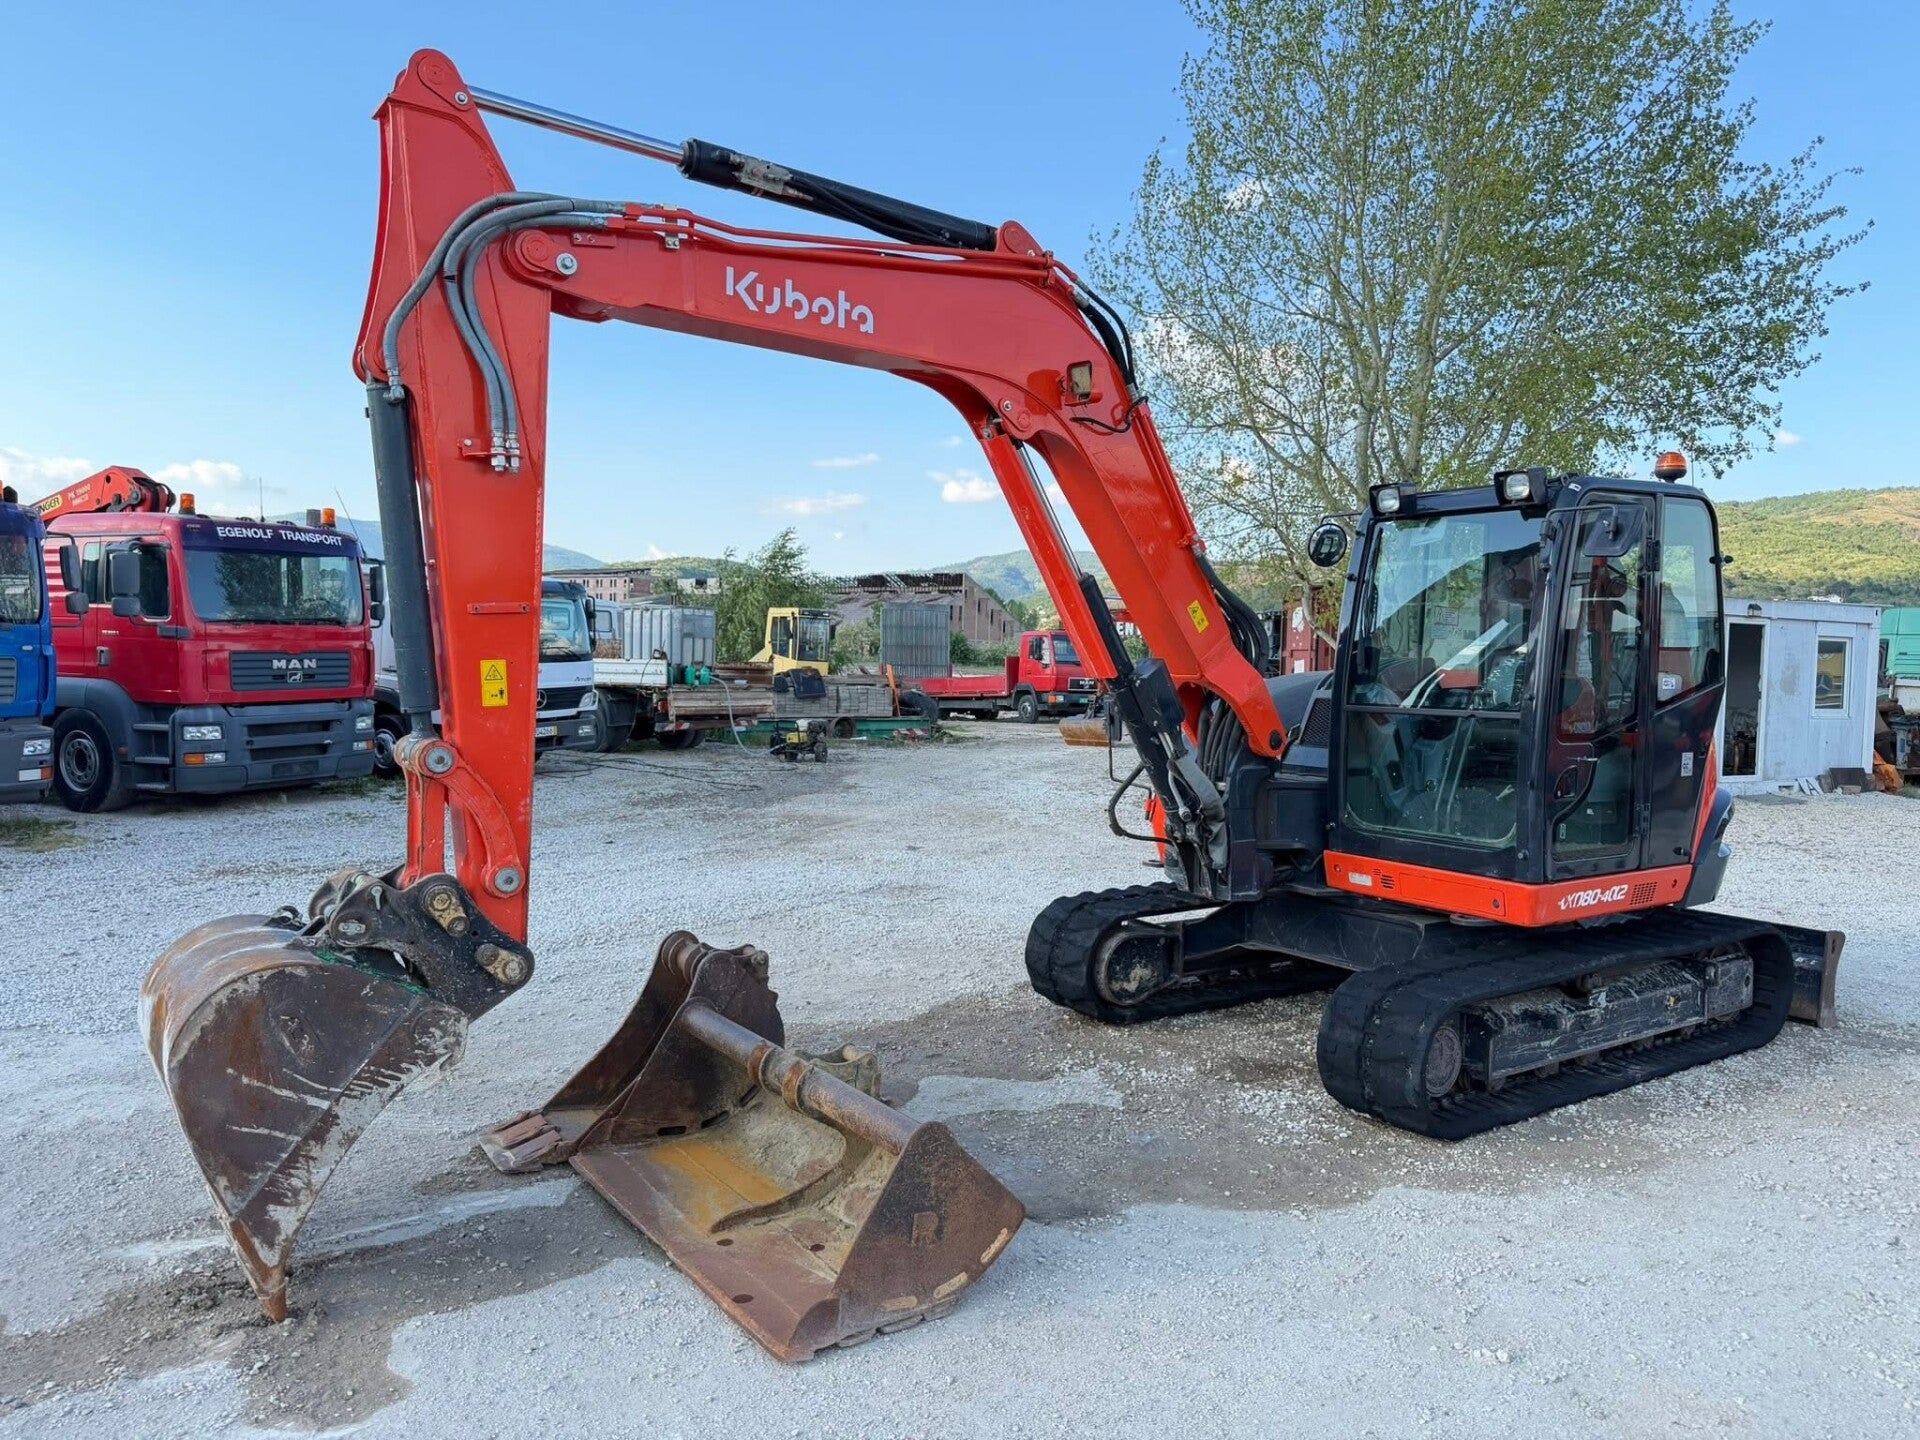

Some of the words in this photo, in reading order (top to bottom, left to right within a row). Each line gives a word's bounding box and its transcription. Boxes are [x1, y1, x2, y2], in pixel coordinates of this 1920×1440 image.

[725, 265, 875, 334] Kubota
[216, 526, 274, 539] EGENOLF
[278, 529, 342, 546] TRANSPORT
[272, 658, 317, 669] MAN
